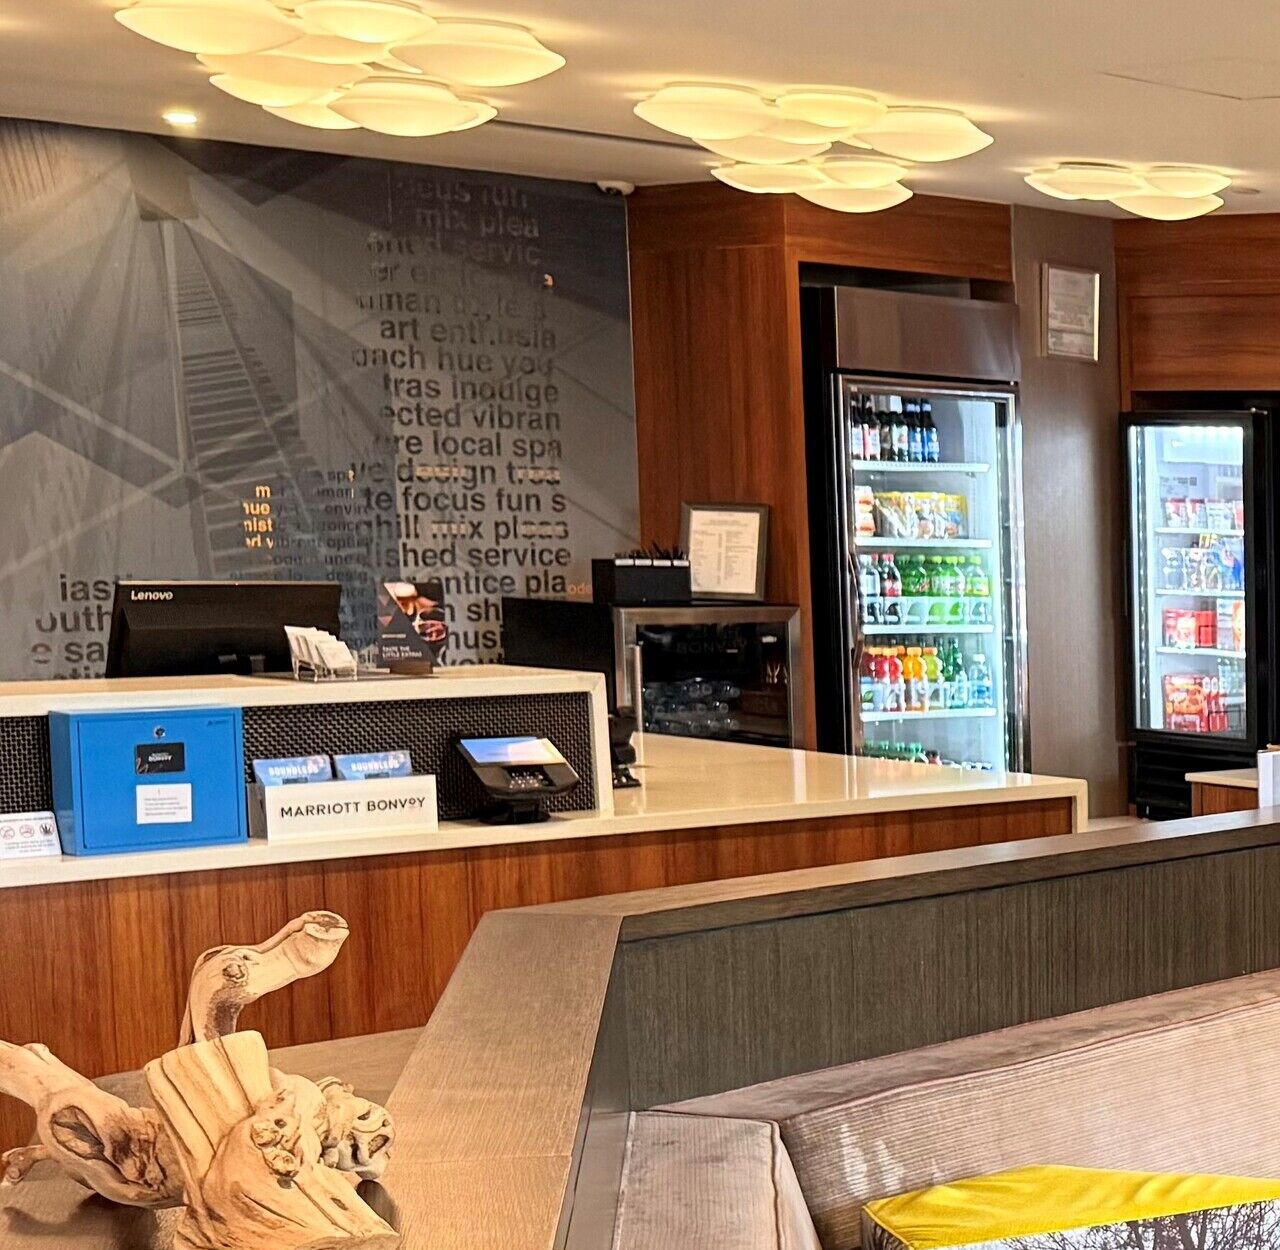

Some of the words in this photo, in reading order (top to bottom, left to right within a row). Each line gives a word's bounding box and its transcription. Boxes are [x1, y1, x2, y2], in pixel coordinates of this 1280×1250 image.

[379, 317, 420, 342] art
[472, 404, 561, 431] vibran
[432, 430, 502, 458] local
[511, 437, 563, 464] spa
[402, 486, 486, 513] focus
[497, 488, 542, 514] fun
[467, 542, 571, 568] service
[130, 589, 174, 602] Lenovo
[525, 575, 567, 598] pla
[280, 801, 361, 819] MARRIOTT
